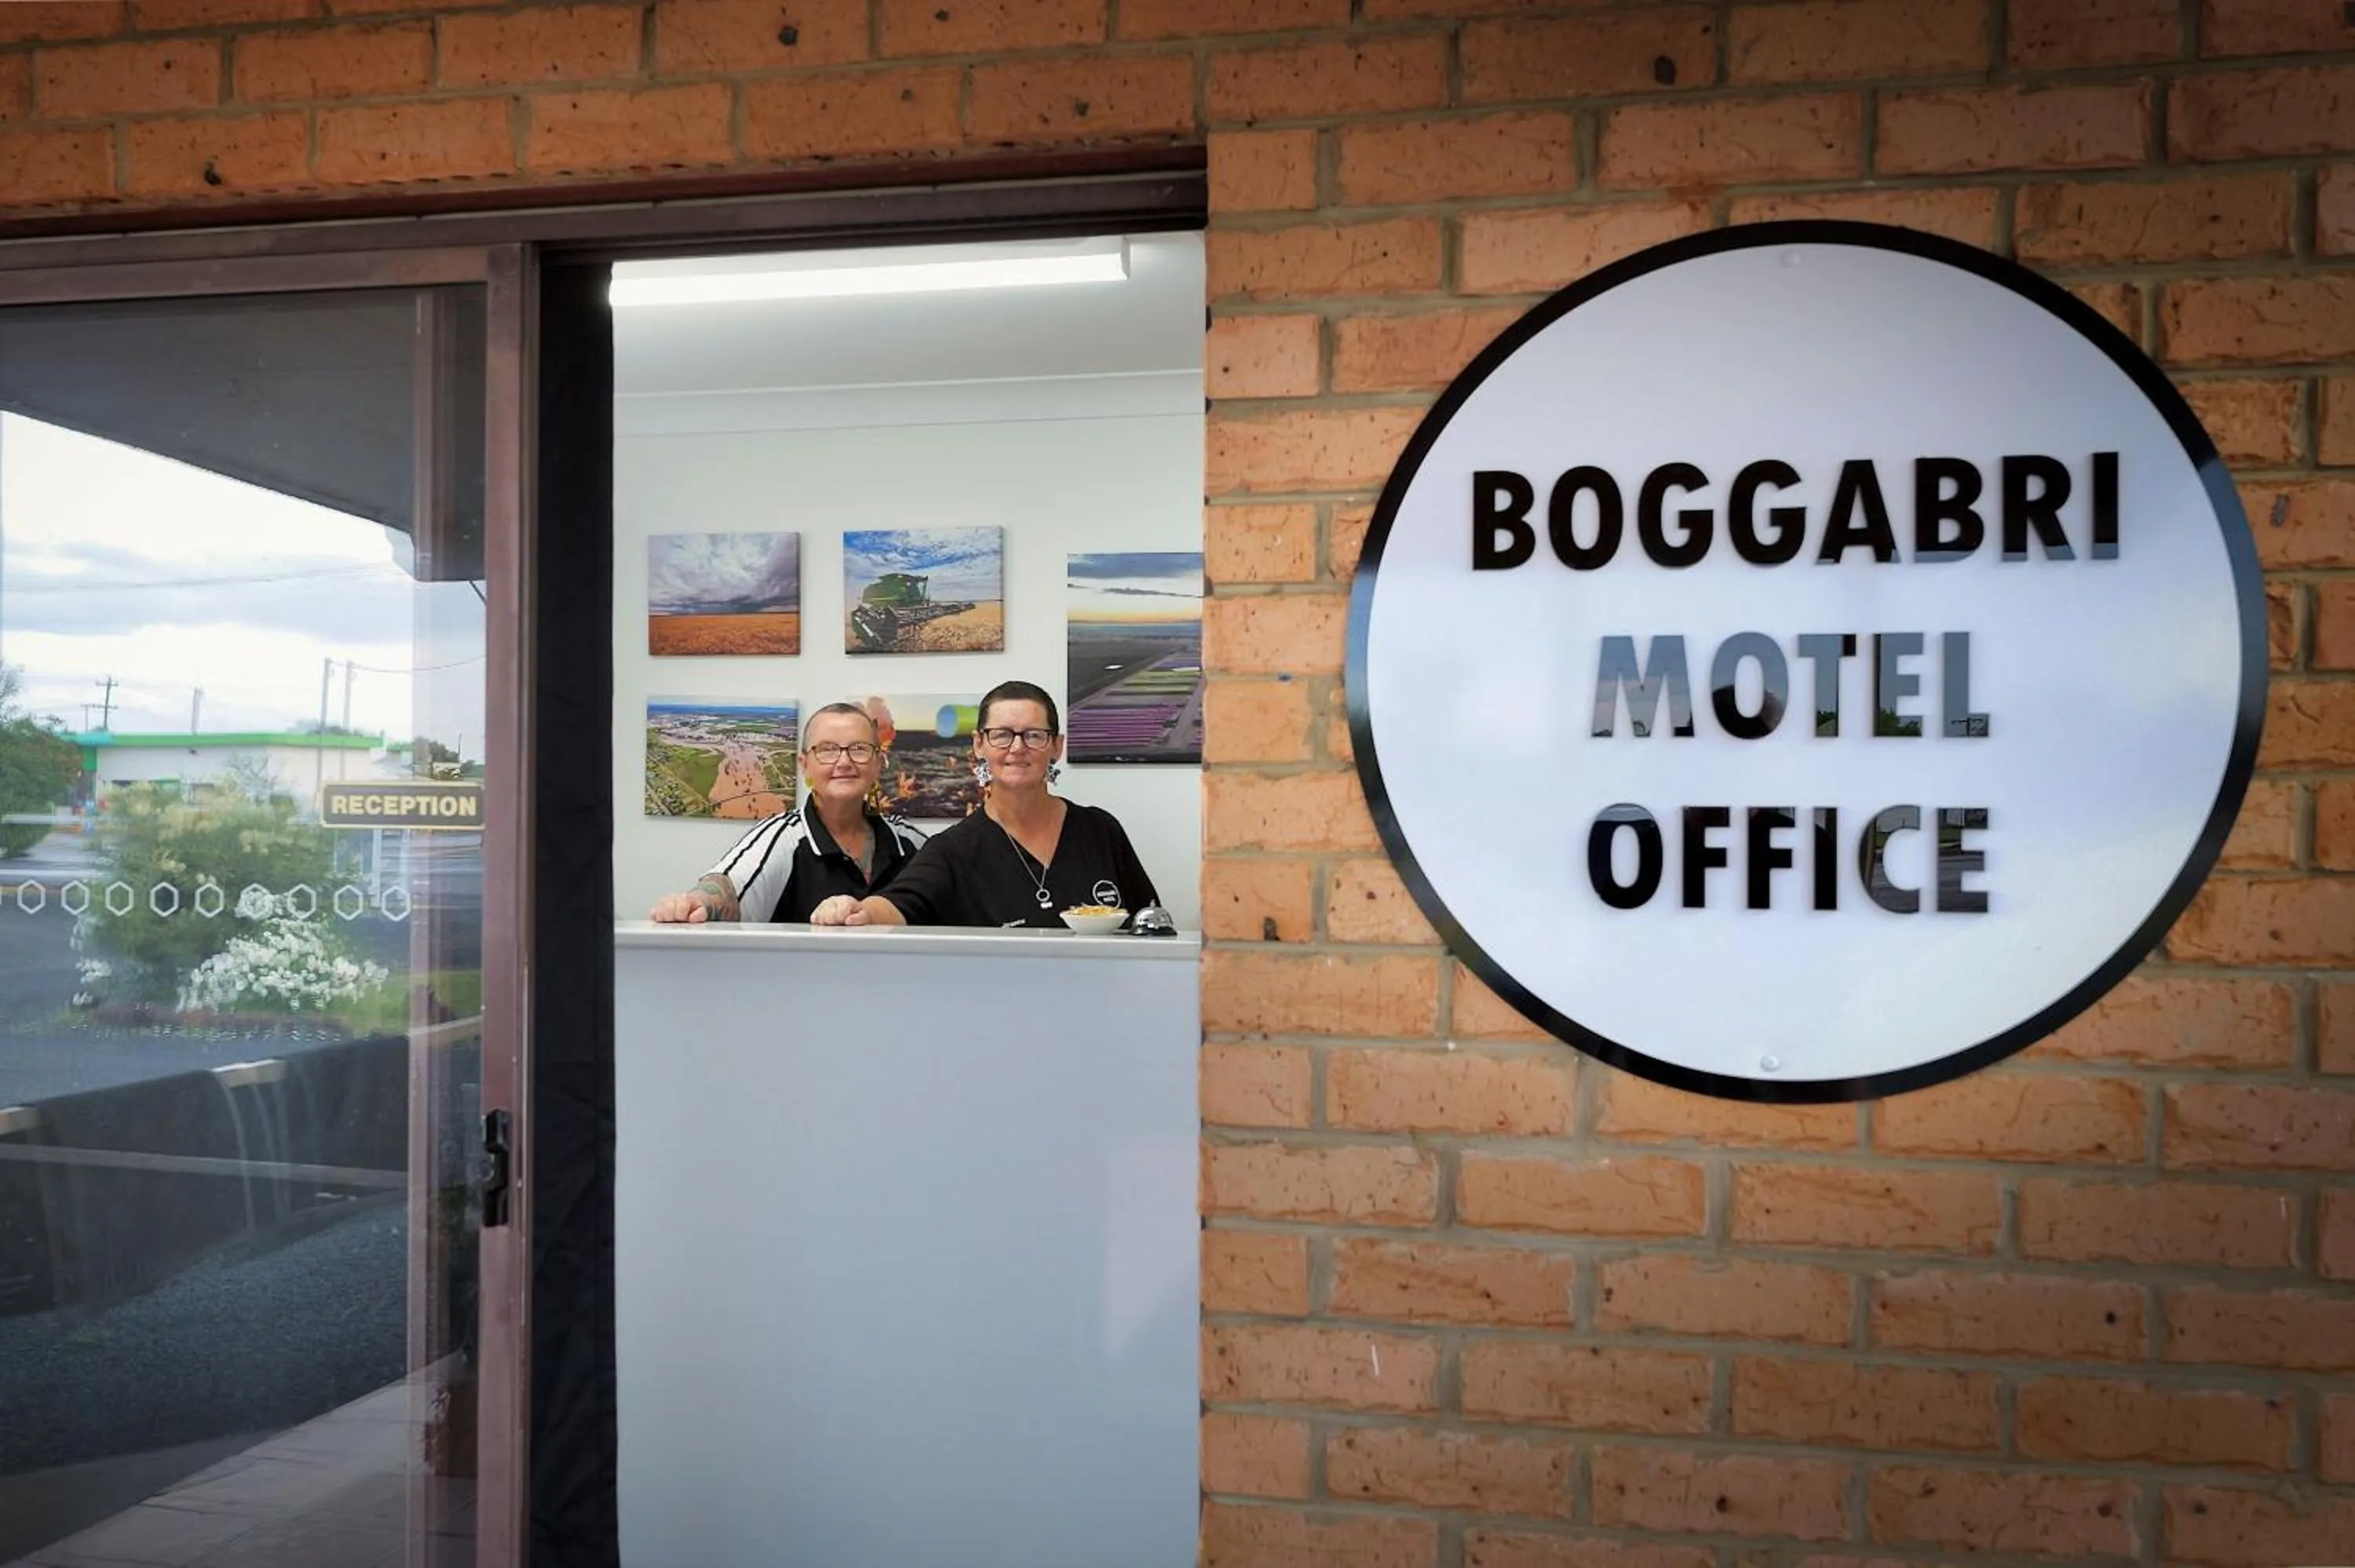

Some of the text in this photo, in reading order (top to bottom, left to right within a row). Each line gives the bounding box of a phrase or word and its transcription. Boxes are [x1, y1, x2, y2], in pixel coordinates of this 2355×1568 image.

[1473, 451, 2119, 571] BOGGABRI
[1590, 631, 1990, 740] MOTEL
[330, 794, 477, 816] RECEPTION
[1587, 802, 1989, 913] OFFICE
